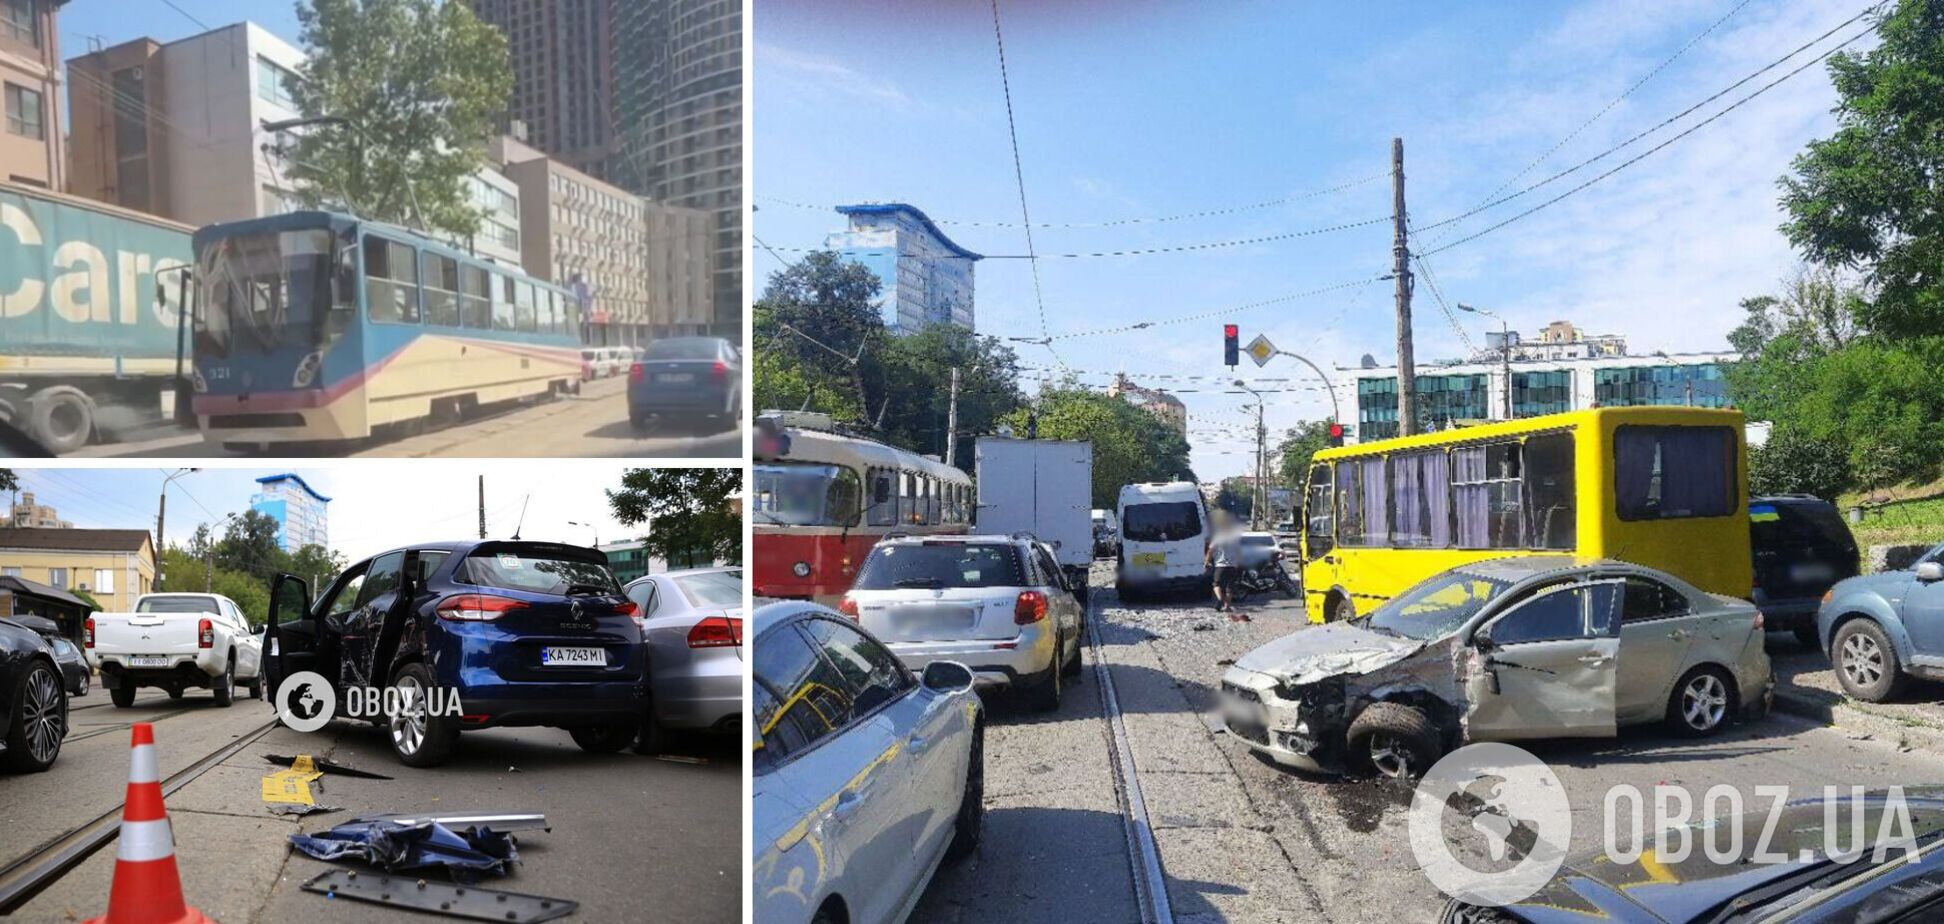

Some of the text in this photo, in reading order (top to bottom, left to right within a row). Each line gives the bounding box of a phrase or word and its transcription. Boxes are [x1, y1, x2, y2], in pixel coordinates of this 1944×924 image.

[548, 649, 602, 661] KA 7243 MI
